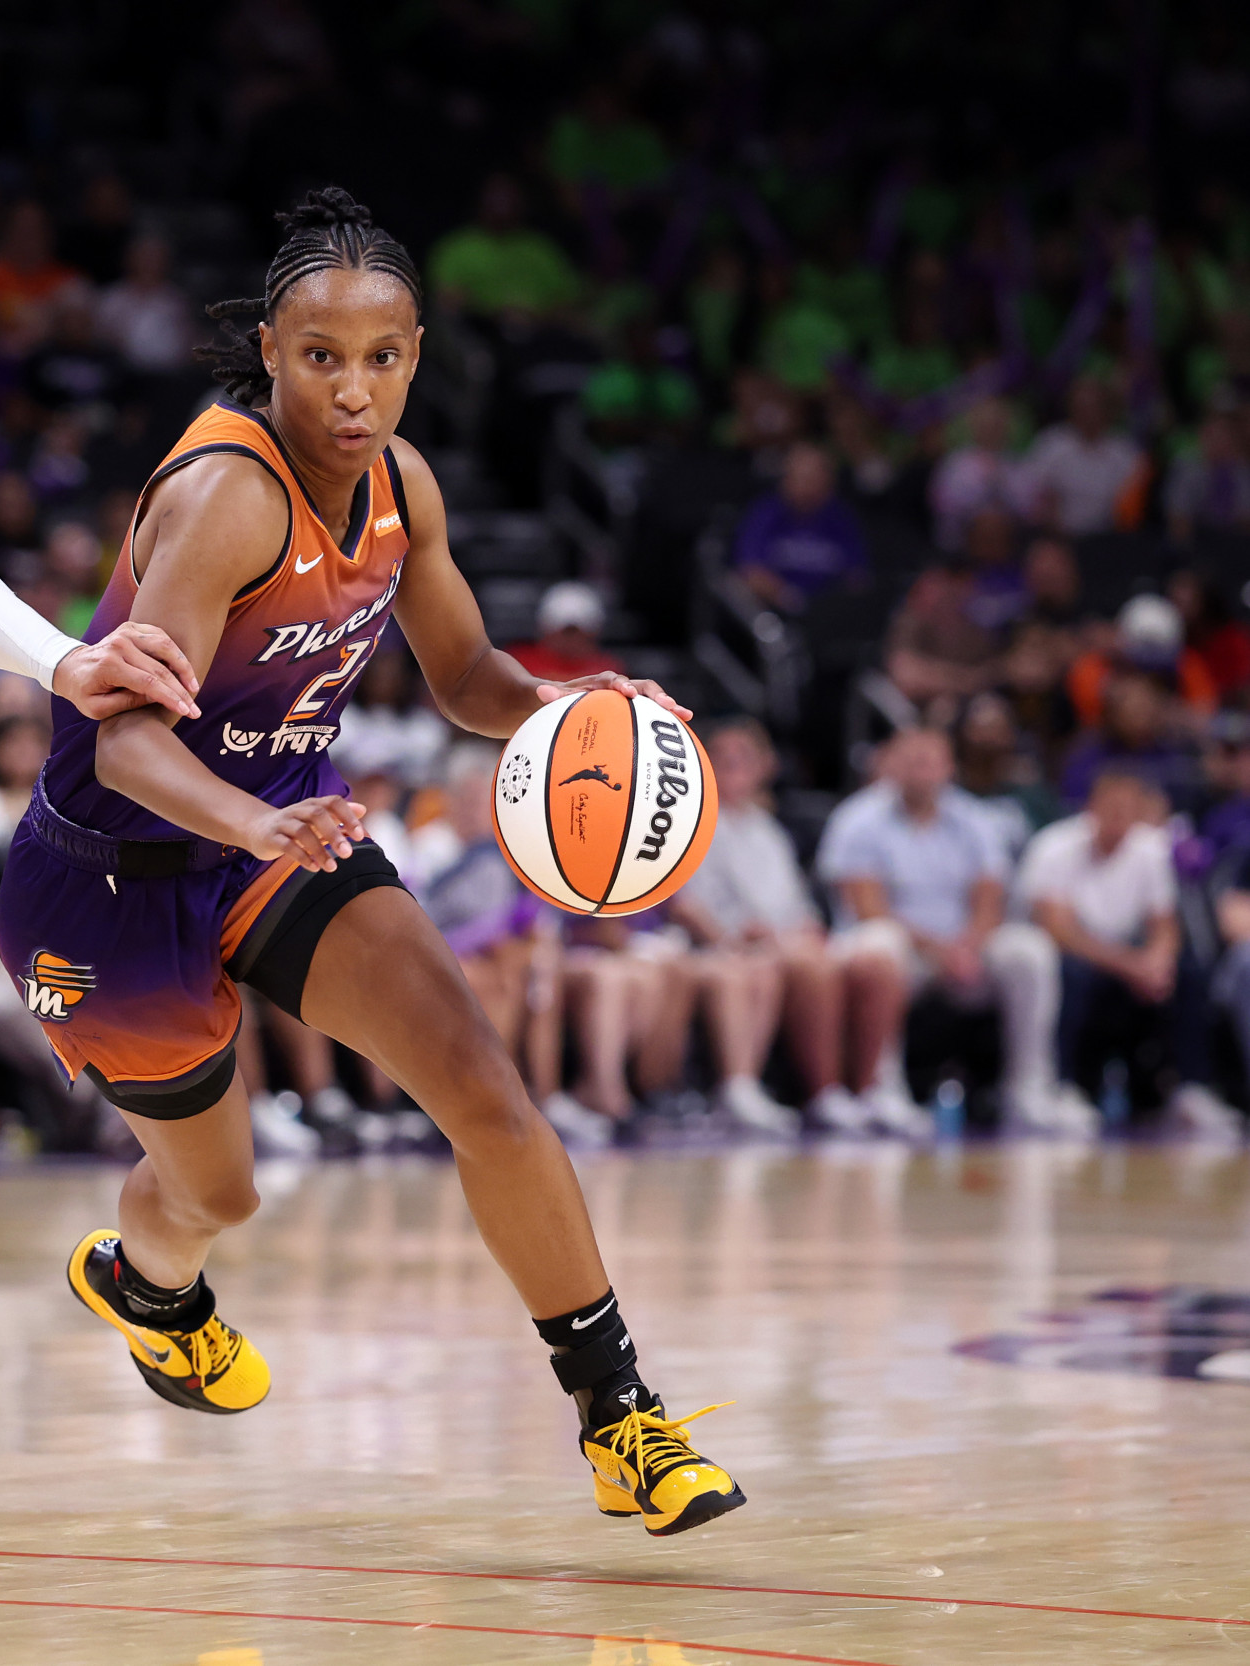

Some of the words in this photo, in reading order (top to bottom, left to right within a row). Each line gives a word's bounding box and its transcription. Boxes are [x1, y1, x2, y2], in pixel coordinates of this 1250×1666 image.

[583, 716, 593, 736] GAME
[588, 720, 599, 751] OFFICIAL
[580, 736, 589, 756] BALL
[635, 719, 690, 861] Wilson
